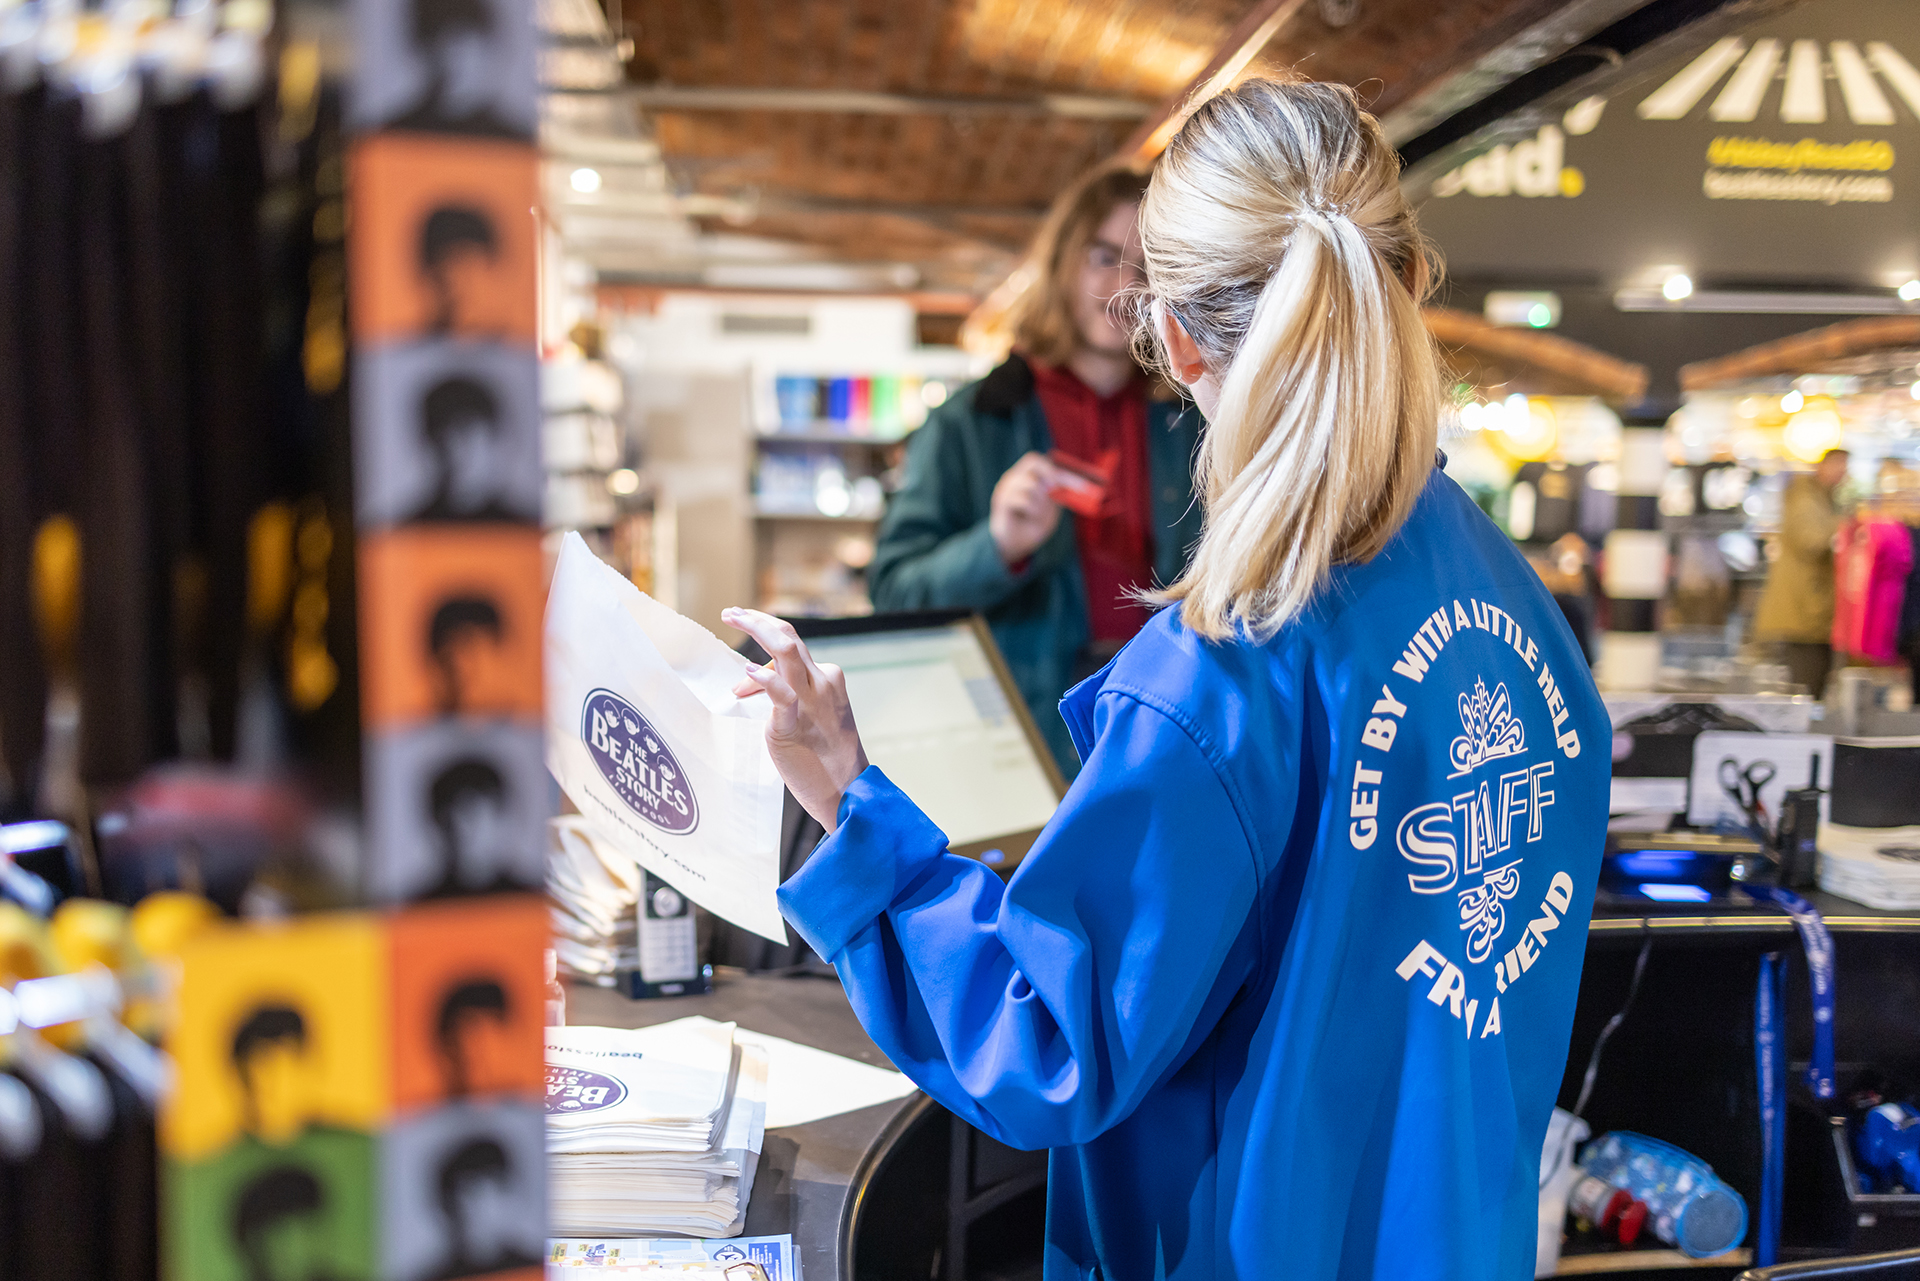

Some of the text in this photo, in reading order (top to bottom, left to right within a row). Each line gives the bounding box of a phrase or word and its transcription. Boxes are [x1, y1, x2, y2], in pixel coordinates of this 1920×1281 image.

[590, 707, 689, 816] BEATLES
[628, 737, 648, 762] THE
[1349, 598, 1581, 851] GET BY WITH A LITTLE HELP
[608, 774, 672, 825] LIVERPOOL
[616, 766, 661, 811] STORY
[1396, 761, 1555, 895] STAFF
[1395, 870, 1574, 1040] FR A IEND
[544, 1044, 643, 1060] beatlessto
